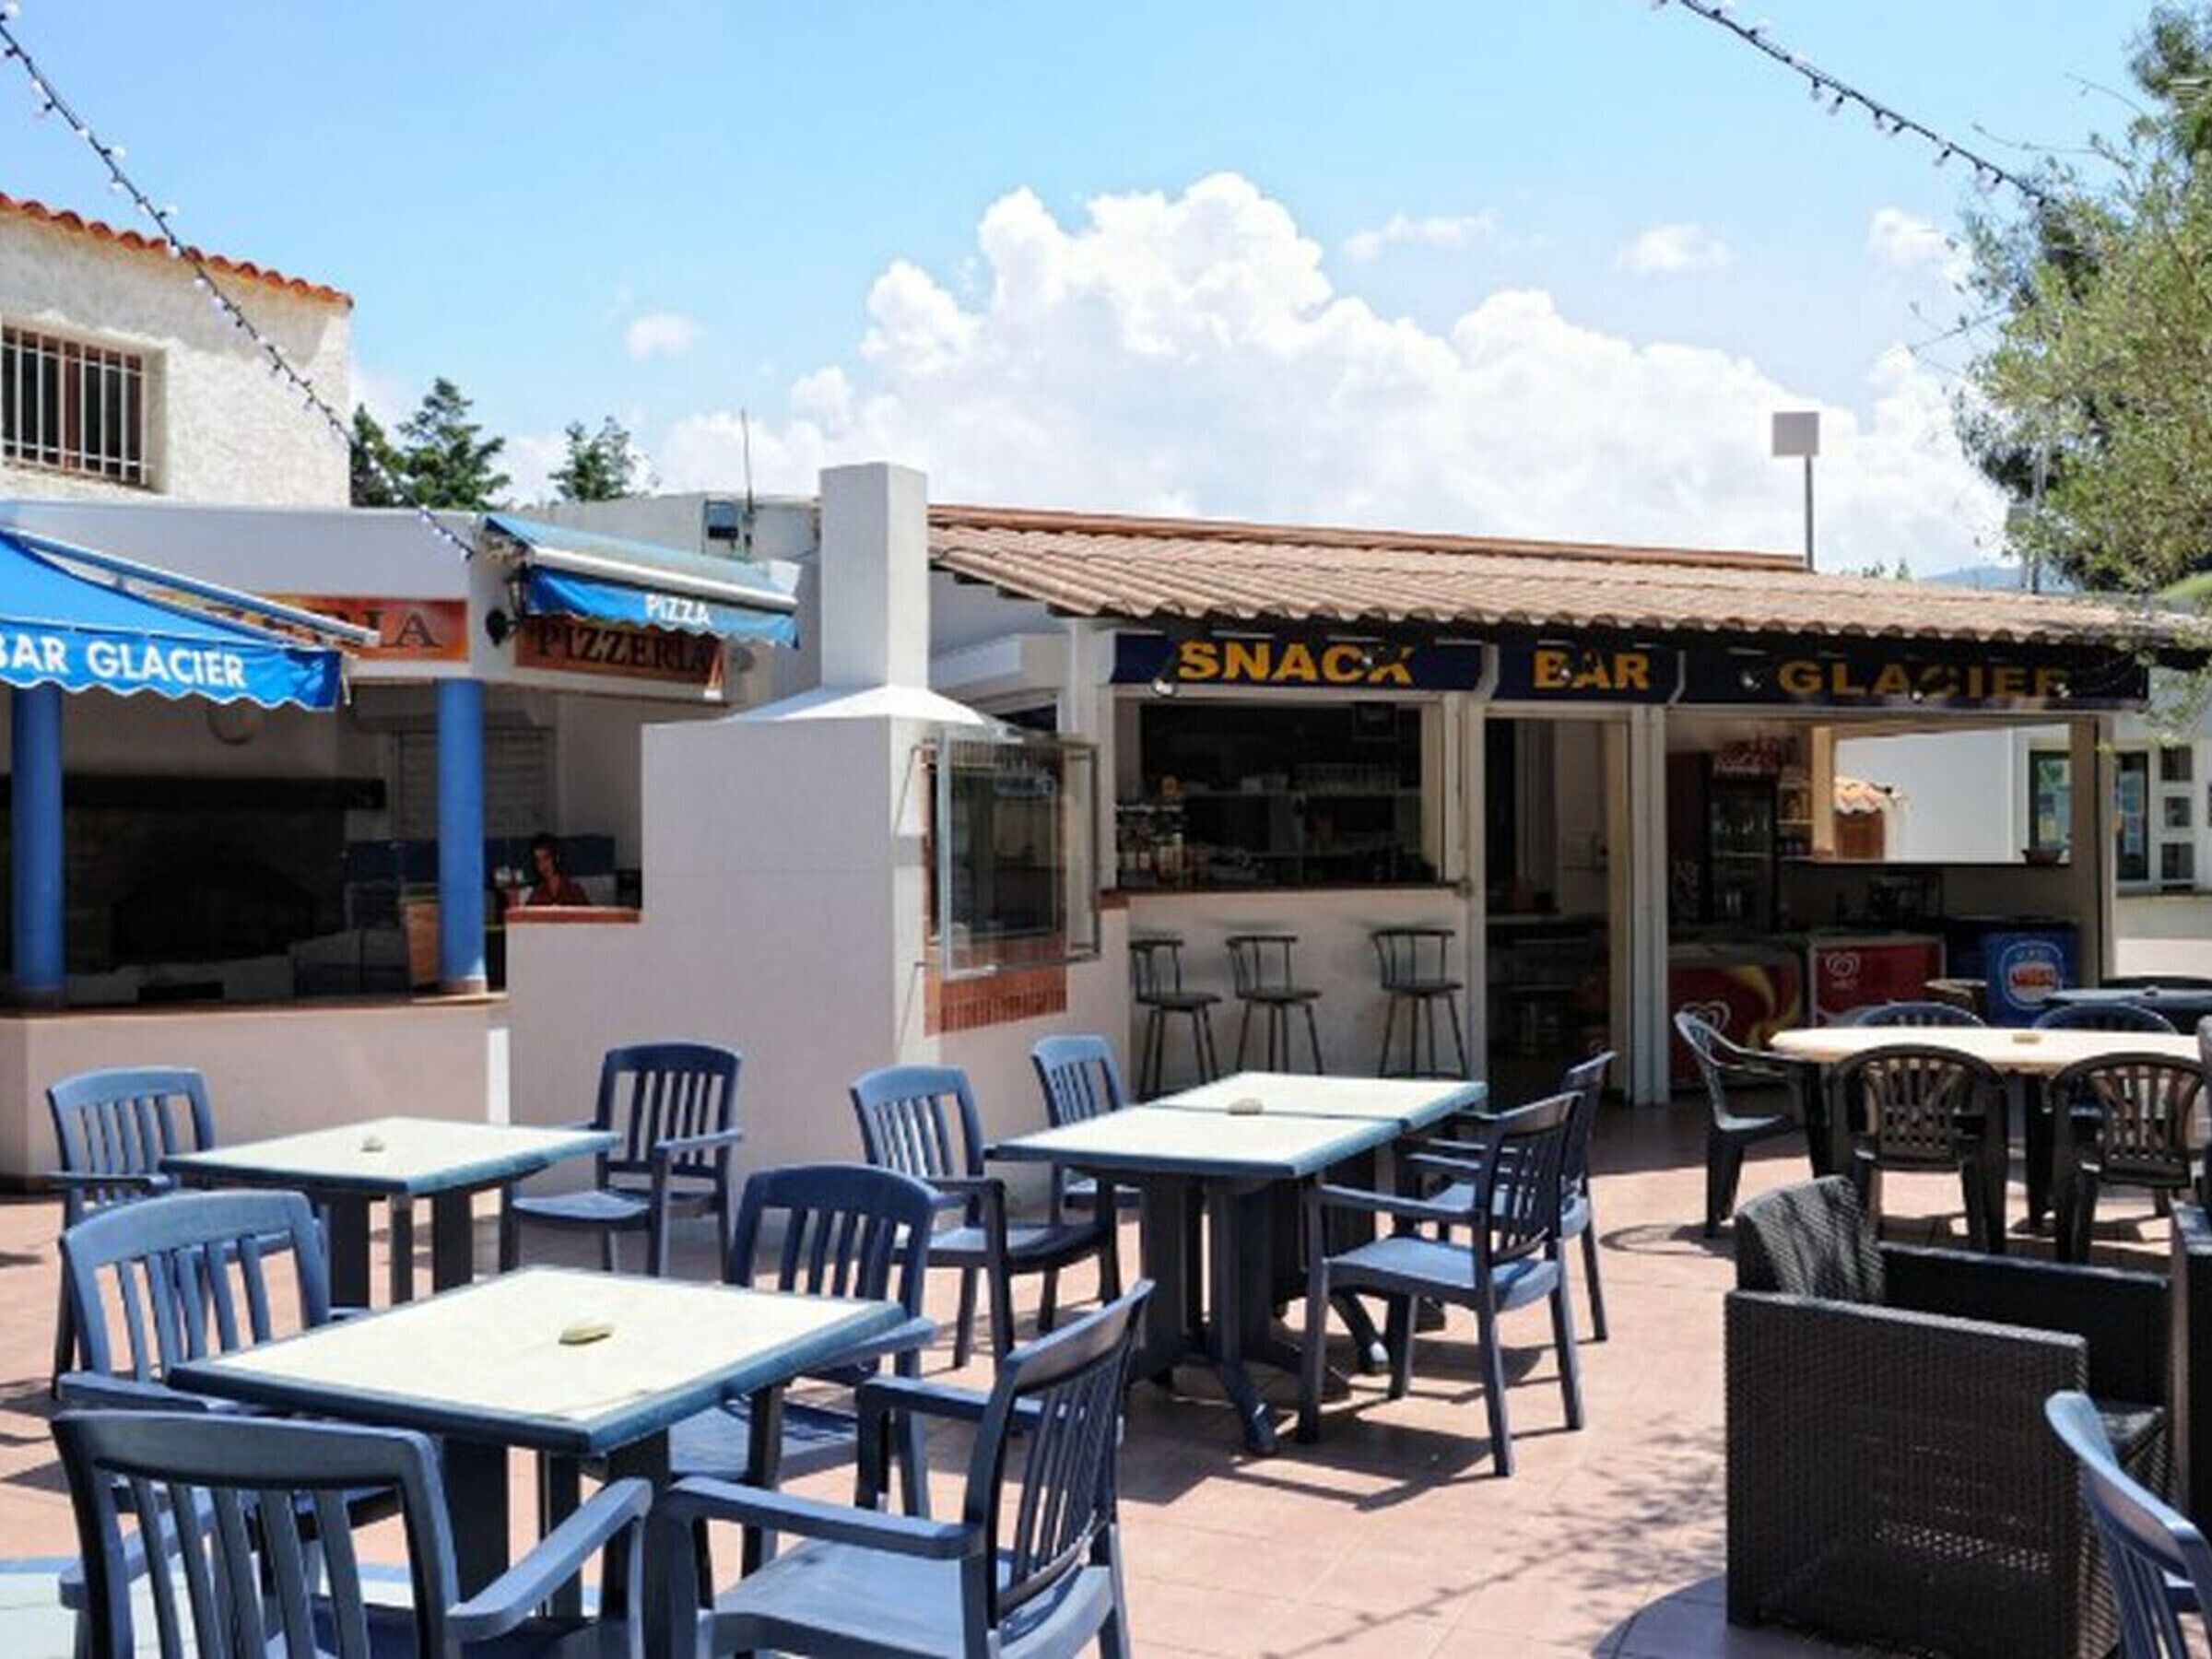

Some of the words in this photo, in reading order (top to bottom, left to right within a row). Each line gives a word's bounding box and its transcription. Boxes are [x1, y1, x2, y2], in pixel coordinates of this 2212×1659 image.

[646, 594, 712, 627] PIZZA
[87, 642, 248, 689] GLACIER
[1534, 650, 1649, 689] BAR
